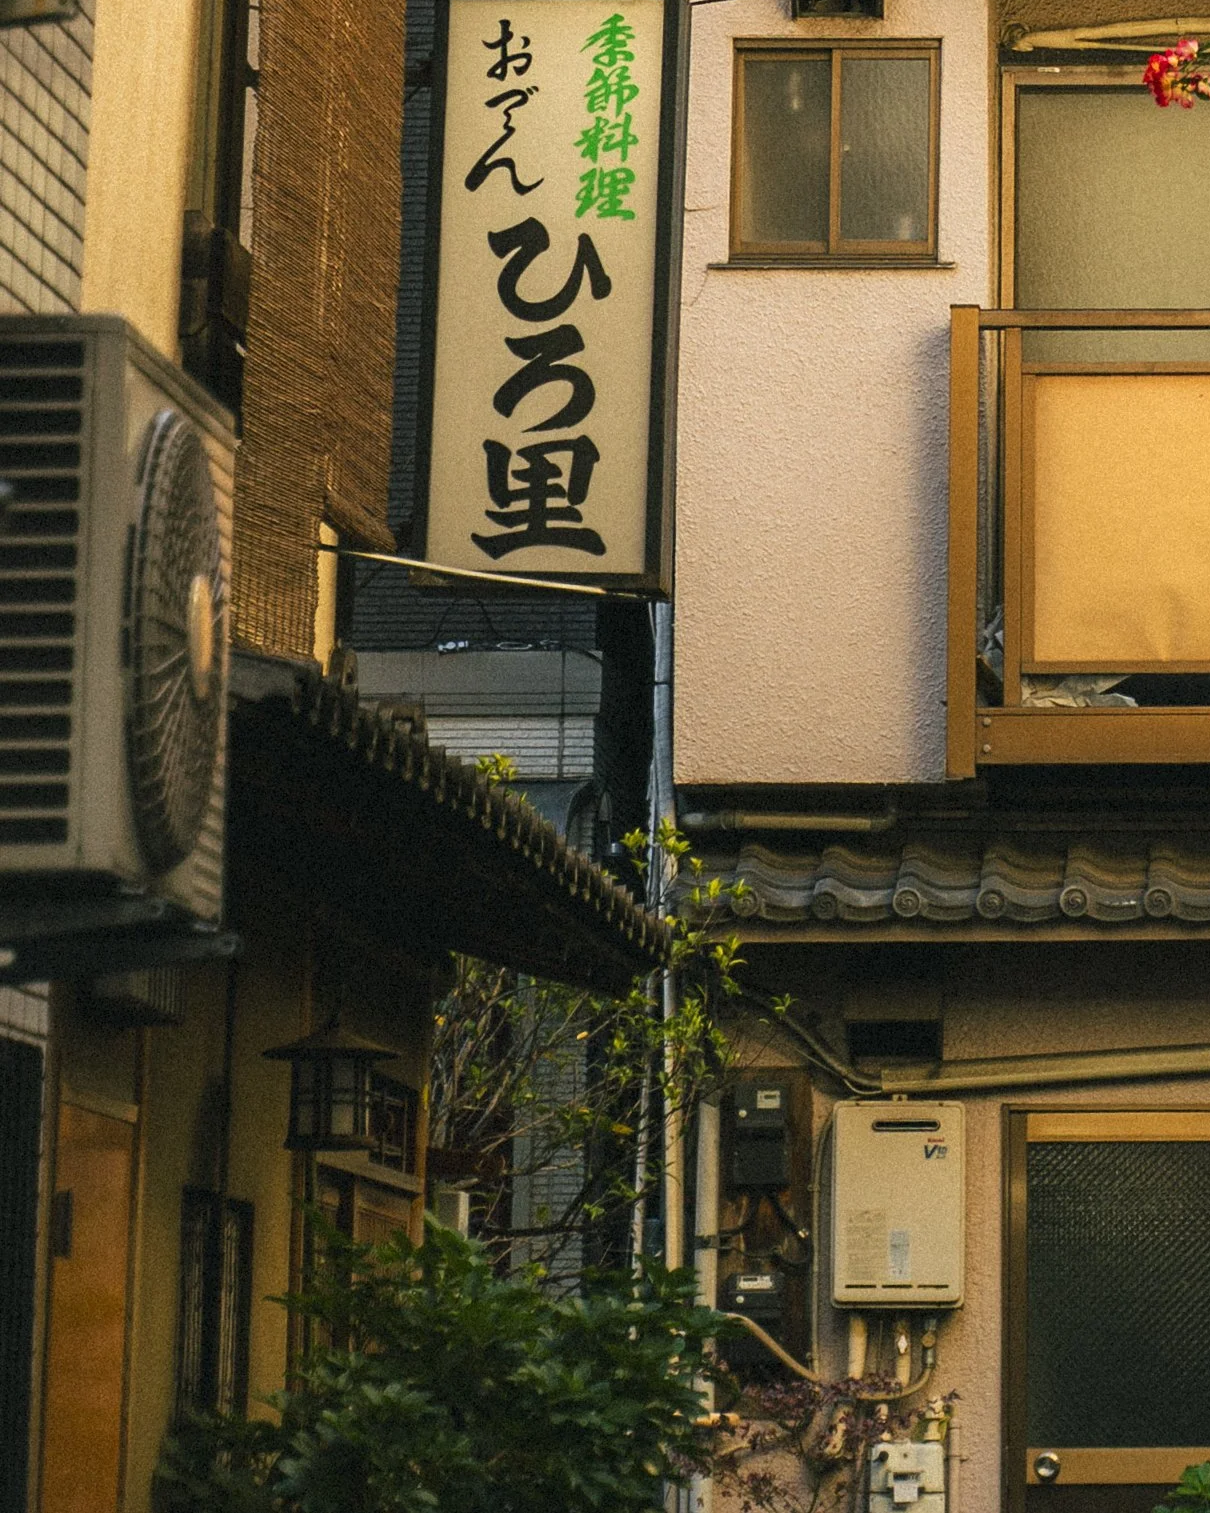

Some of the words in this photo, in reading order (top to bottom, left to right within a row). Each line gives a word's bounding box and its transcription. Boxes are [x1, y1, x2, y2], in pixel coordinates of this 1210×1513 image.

[464, 18, 545, 196] おでん
[573, 13, 640, 221] 季節料理
[470, 216, 612, 561] ひろ里
